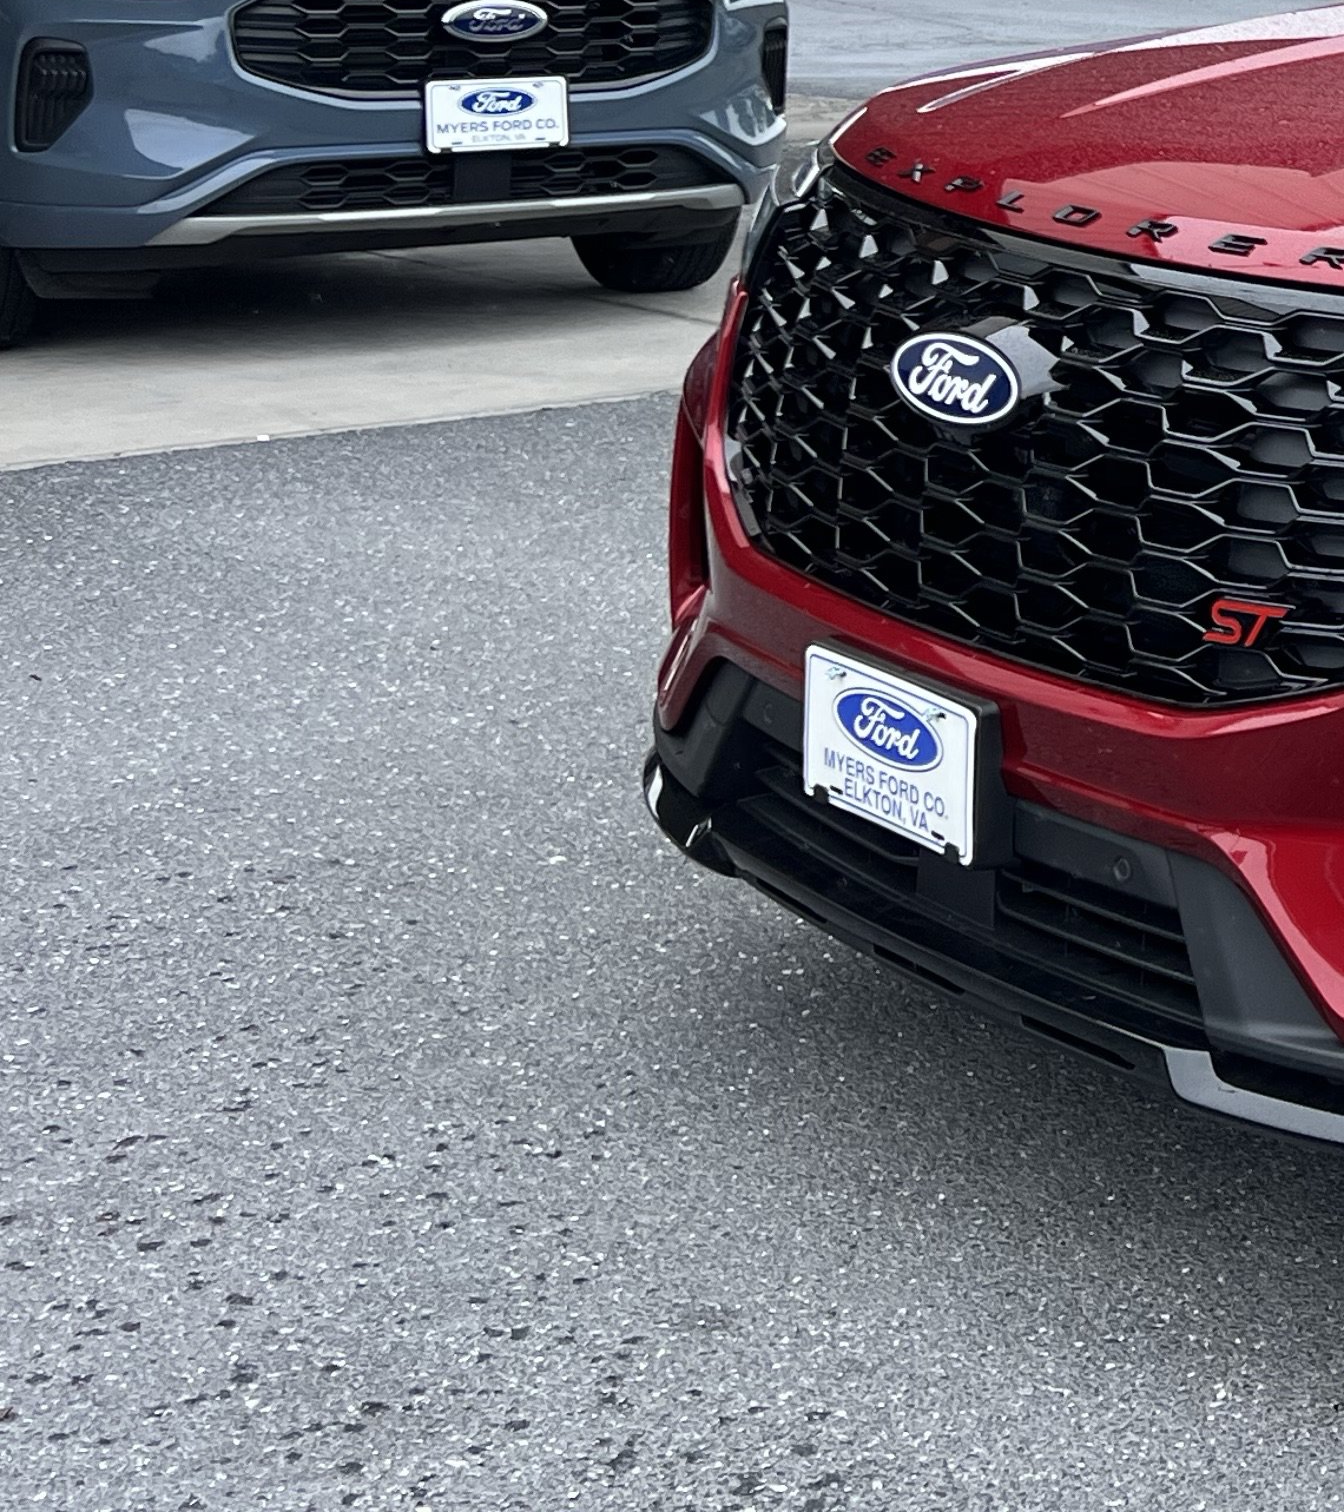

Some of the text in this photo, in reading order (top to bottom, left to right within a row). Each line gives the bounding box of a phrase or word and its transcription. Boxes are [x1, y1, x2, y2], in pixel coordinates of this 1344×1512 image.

[469, 8, 526, 32] Ford
[437, 118, 560, 134] MYERS FORD CO.
[471, 91, 523, 113] Ford
[908, 341, 997, 413] Ford
[1202, 599, 1289, 647] ST
[853, 696, 921, 760] Ford
[823, 747, 949, 820] MYERS FORD CO.
[844, 778, 930, 832] ELKTON, VA
